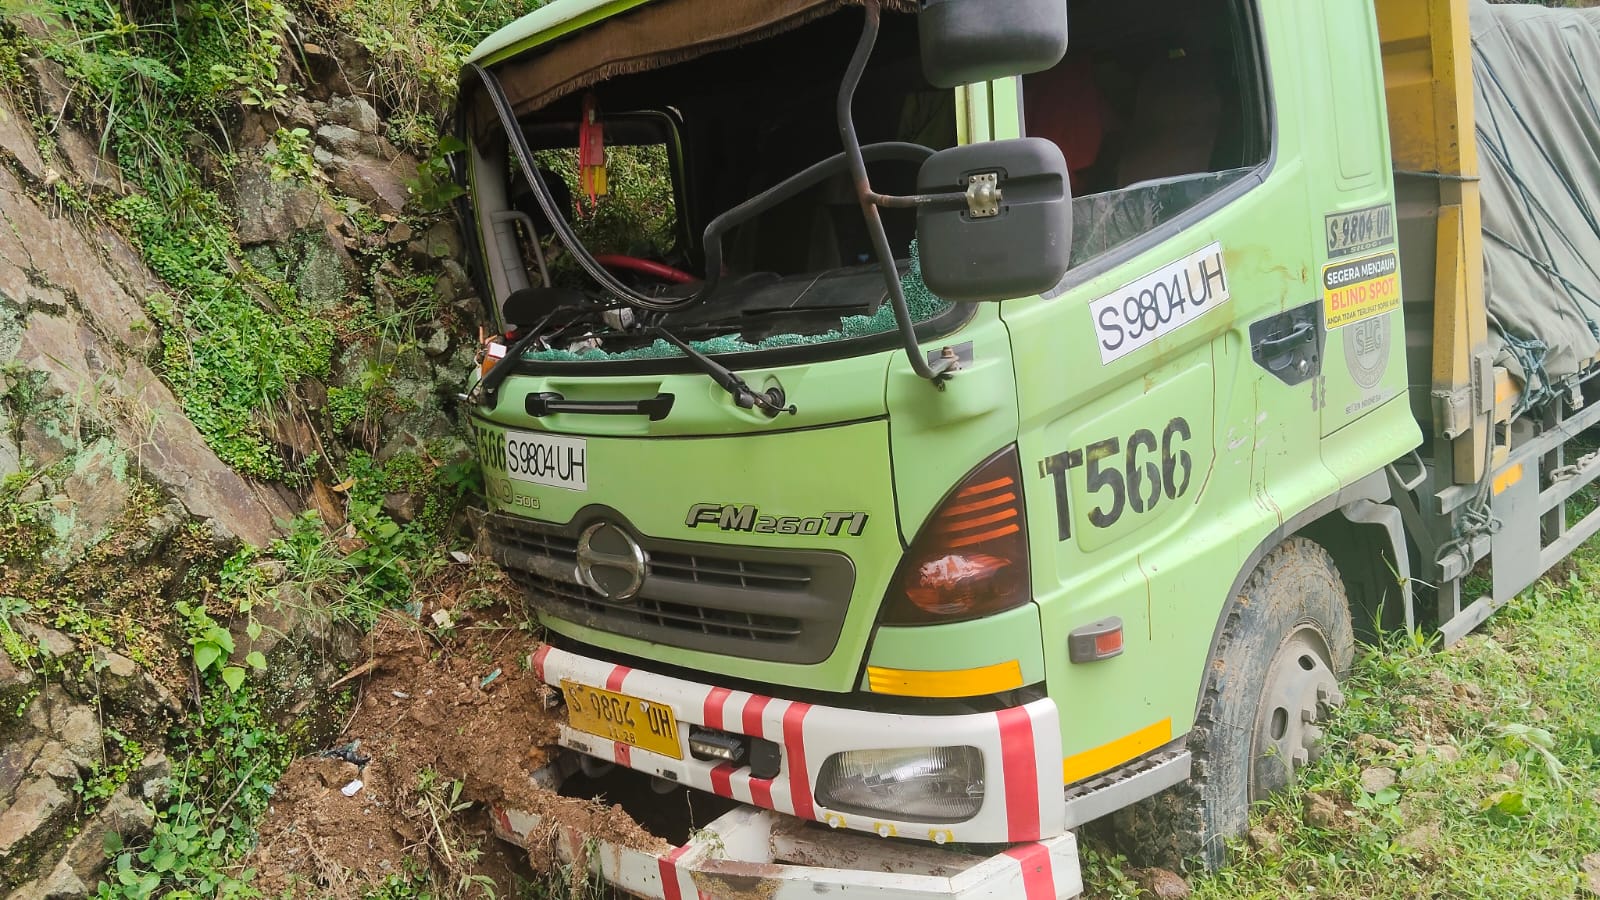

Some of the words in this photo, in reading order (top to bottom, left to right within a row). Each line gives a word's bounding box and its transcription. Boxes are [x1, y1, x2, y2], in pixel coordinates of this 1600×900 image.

[1327, 266, 1360, 285] SEGERA
[1361, 257, 1395, 277] MENJAUH
[1331, 285, 1366, 311] BLIND
[1369, 277, 1394, 300] SPOT
[1038, 417, 1192, 542] T566
[516, 493, 541, 510] 500
[568, 686, 582, 713] S
[590, 691, 635, 728] 9804
[646, 704, 673, 740] UH
